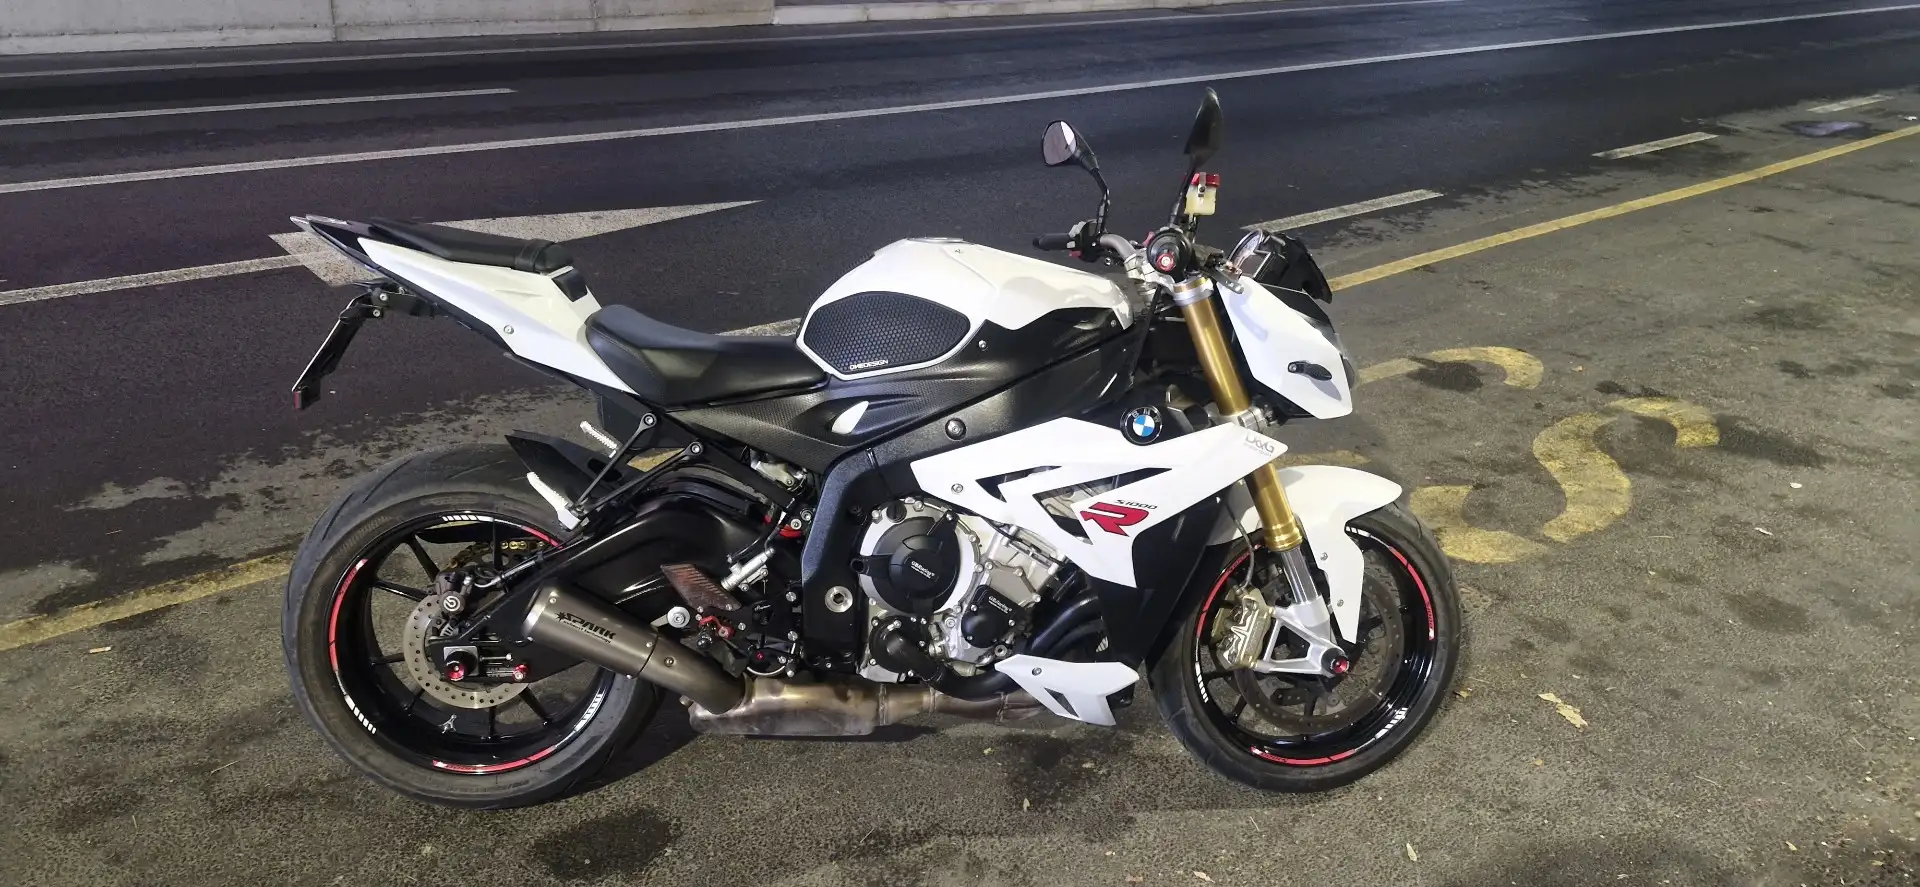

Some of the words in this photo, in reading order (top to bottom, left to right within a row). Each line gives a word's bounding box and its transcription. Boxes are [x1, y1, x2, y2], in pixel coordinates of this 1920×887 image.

[1130, 407, 1160, 422] BMW
[1115, 499, 1158, 510] S1000
[1079, 501, 1150, 537] R
[565, 612, 617, 640] SPARK
